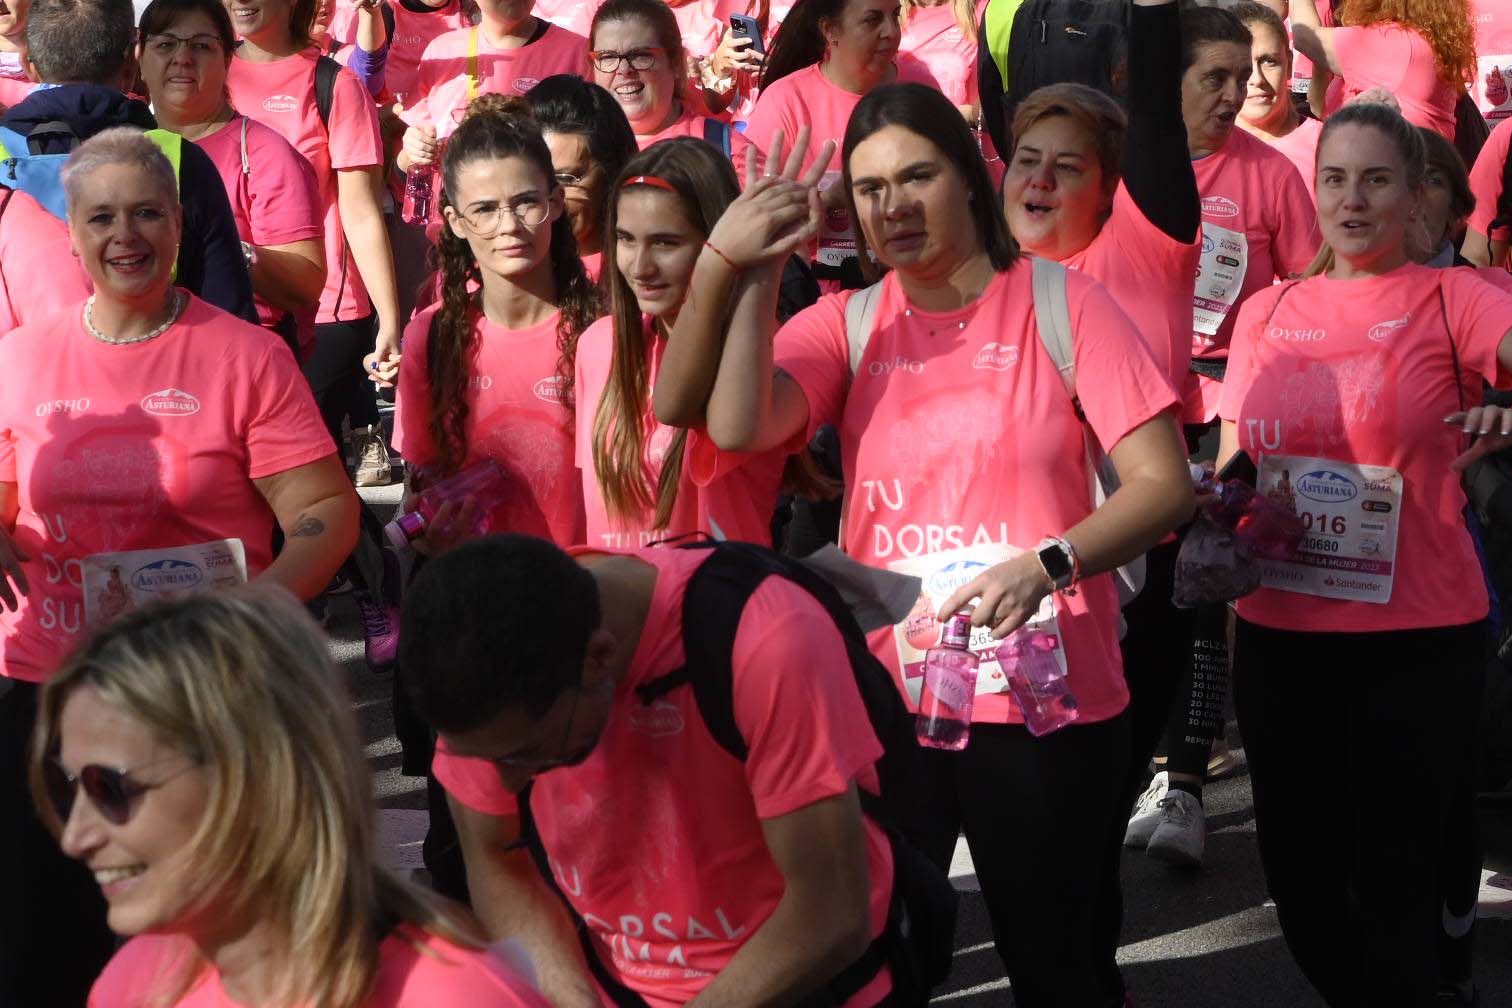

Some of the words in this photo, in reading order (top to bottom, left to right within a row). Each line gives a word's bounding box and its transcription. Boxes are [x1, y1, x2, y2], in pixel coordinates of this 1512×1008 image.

[830, 240, 856, 248] CARRER
[1220, 242, 1242, 254] SUMA
[1270, 327, 1326, 341] OYSHO
[1246, 418, 1281, 450] TU
[1301, 478, 1354, 497] ASTURIANA
[1363, 481, 1392, 493] SUMA
[862, 478, 904, 512] TU
[1300, 511, 1347, 535] 016
[1335, 577, 1382, 592] Santander
[1190, 700, 1202, 708] 20
[1189, 709, 1201, 717] 40
[1188, 717, 1200, 726] 30
[555, 863, 582, 897] U
